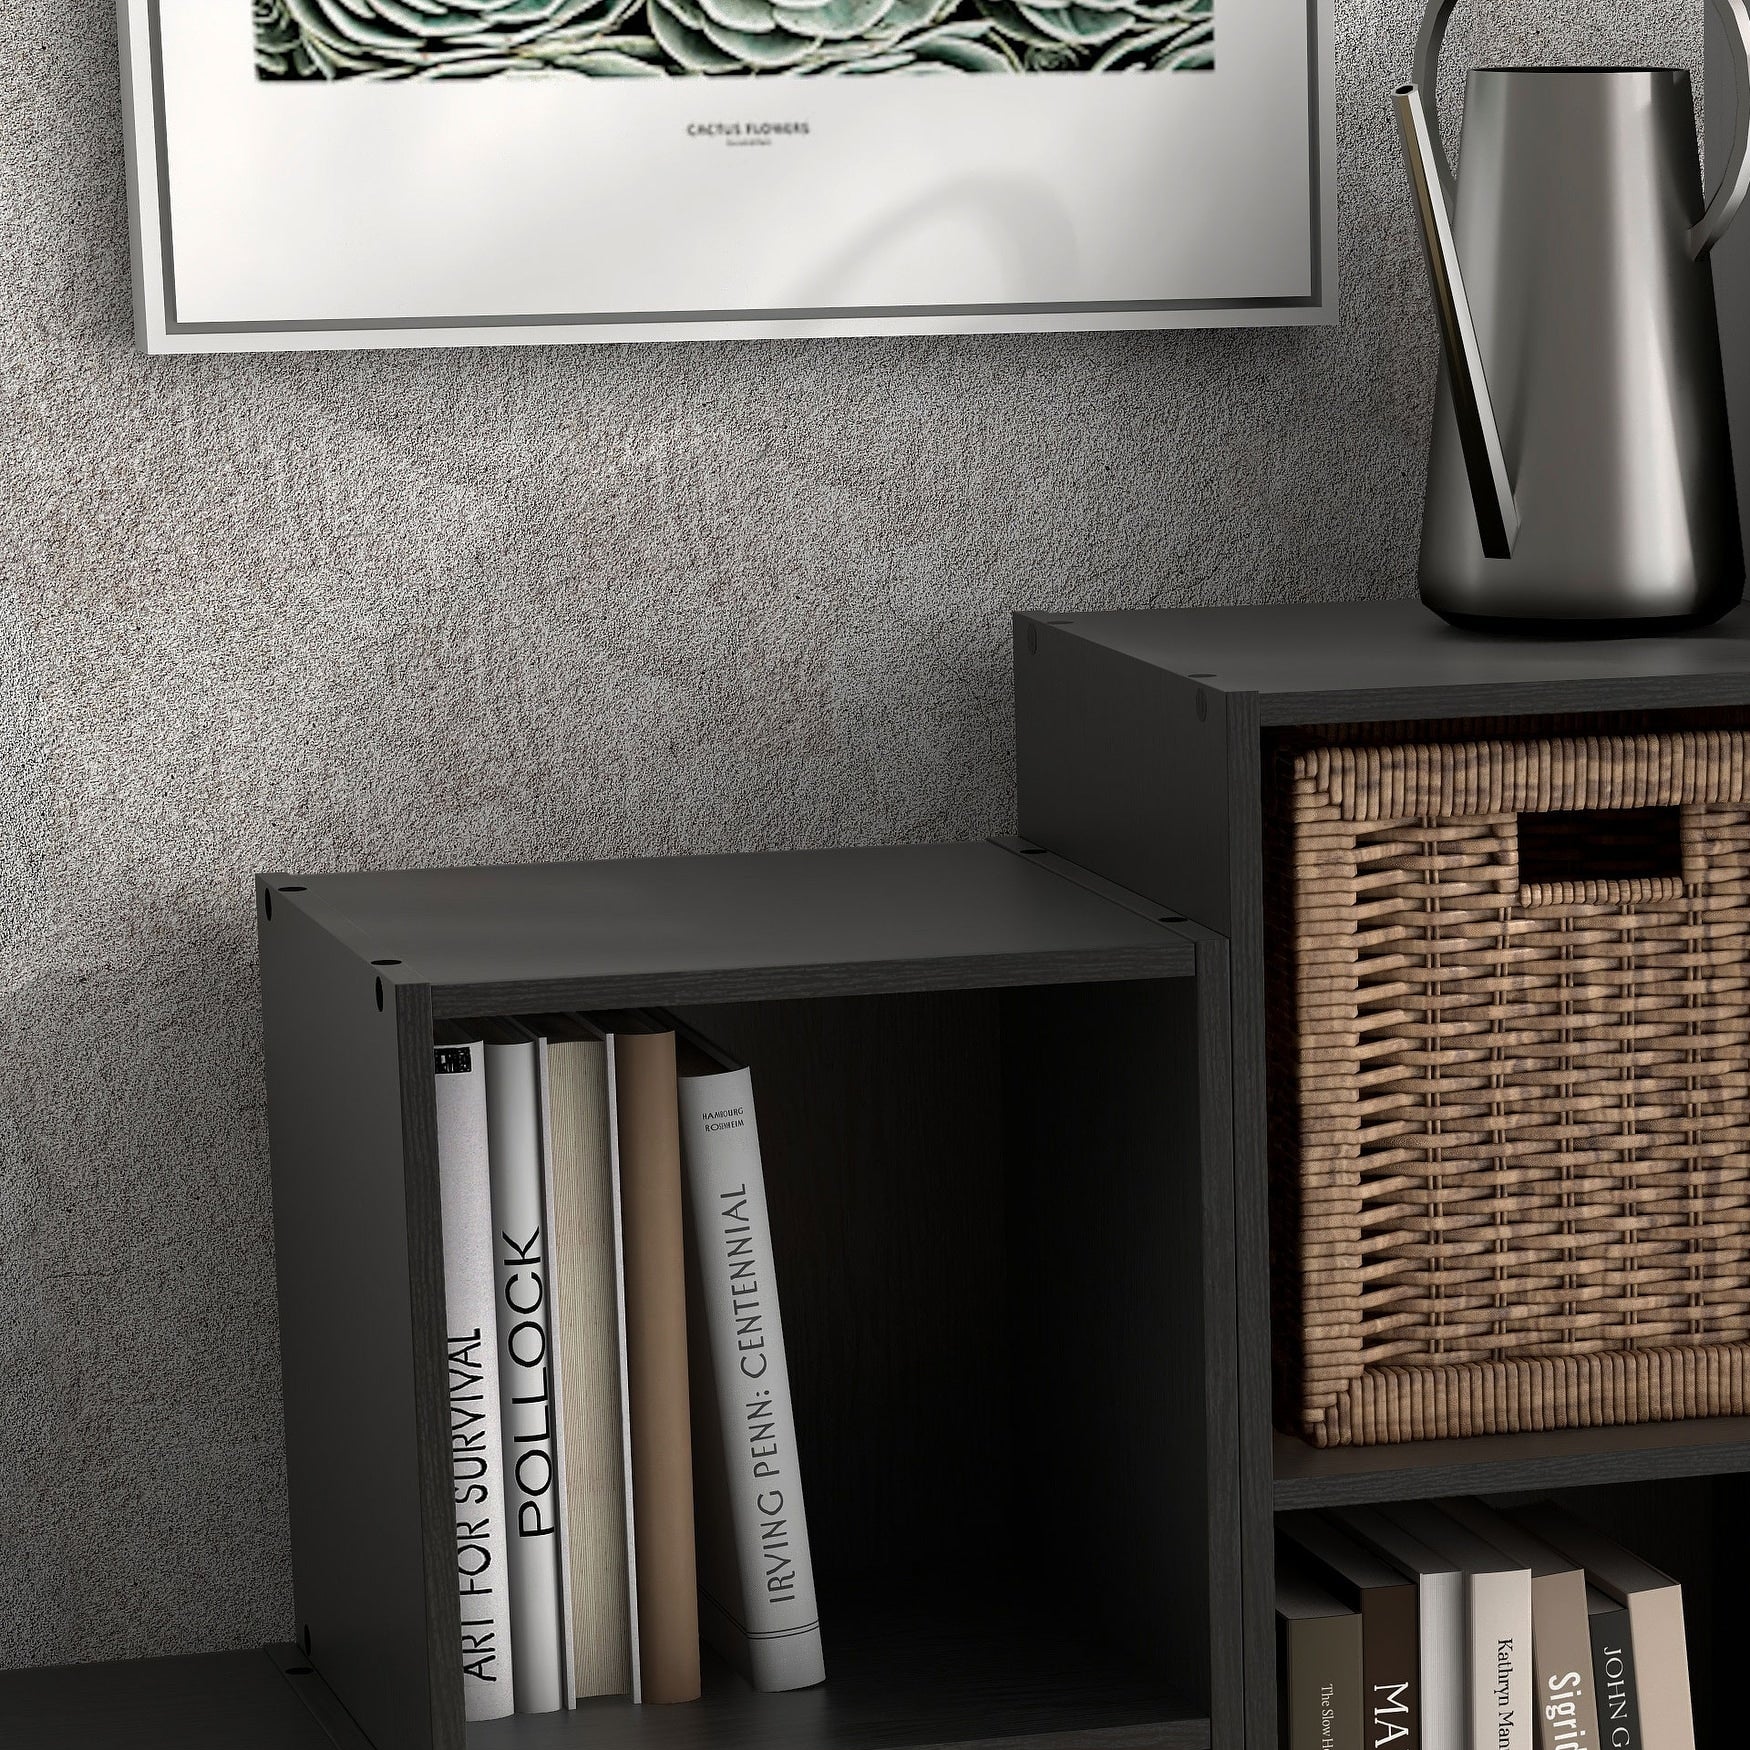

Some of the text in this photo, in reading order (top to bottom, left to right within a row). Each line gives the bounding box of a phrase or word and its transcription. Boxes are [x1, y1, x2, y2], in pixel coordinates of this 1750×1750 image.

[687, 121, 810, 136] CACTUS FLOWERS
[702, 1107, 744, 1120] HAMBOURG
[447, 1328, 489, 1505] SURVIVAL
[501, 1226, 555, 1538] POLLOCK
[720, 1183, 796, 1603] IRVING PENN: CENTENNIAL
[456, 1518, 493, 1596] FOR
[1321, 1683, 1333, 1707] The
[1494, 1638, 1513, 1706] Kathryn
[1603, 1646, 1628, 1720] JOHN
[1321, 1707, 1334, 1737] Slow
